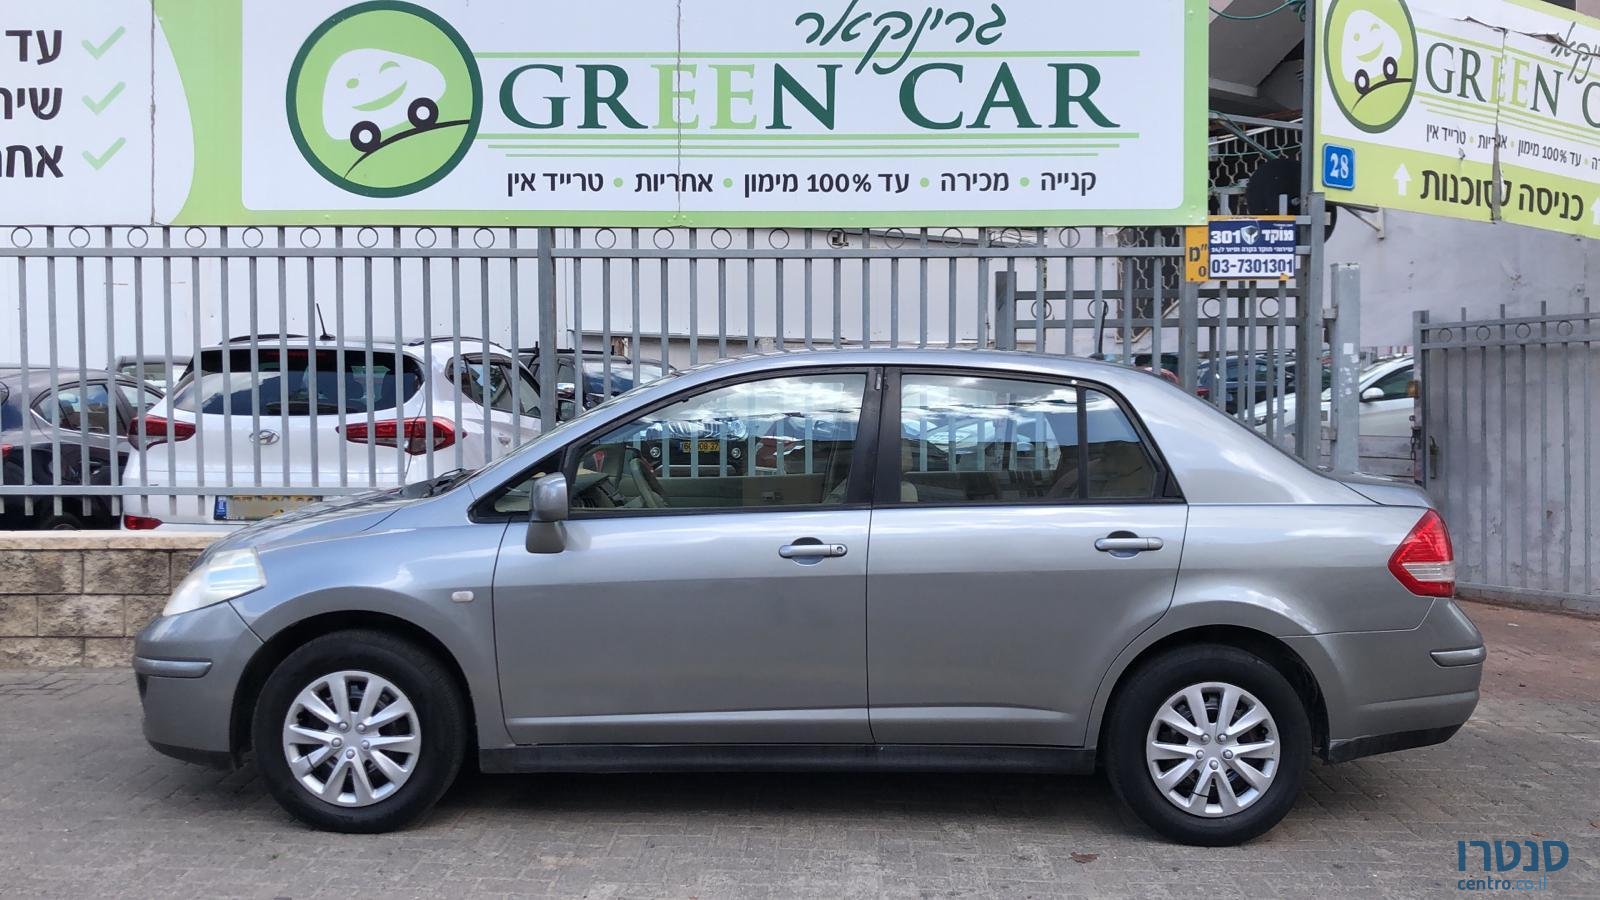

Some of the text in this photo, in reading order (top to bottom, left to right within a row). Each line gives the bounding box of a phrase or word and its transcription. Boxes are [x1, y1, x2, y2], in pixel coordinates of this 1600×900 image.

[5, 30, 63, 65] עד
[1425, 41, 1564, 117] GREEN
[499, 61, 1121, 131] GREEN CAR
[1426, 123, 1440, 142] אין
[1441, 126, 1467, 145] טרייד
[1517, 139, 1540, 157] מימון
[1542, 145, 1567, 164] 100%
[1569, 151, 1582, 167] עד
[0, 144, 64, 178] אח
[1330, 151, 1349, 179] 28
[507, 171, 1097, 198] קנייה מכירה עד 100% מימון אחריות טרייד אין
[1518, 184, 1584, 222] כניסה
[1210, 228, 1294, 244] מוקד 301
[1211, 258, 1293, 274] 03-7301301
